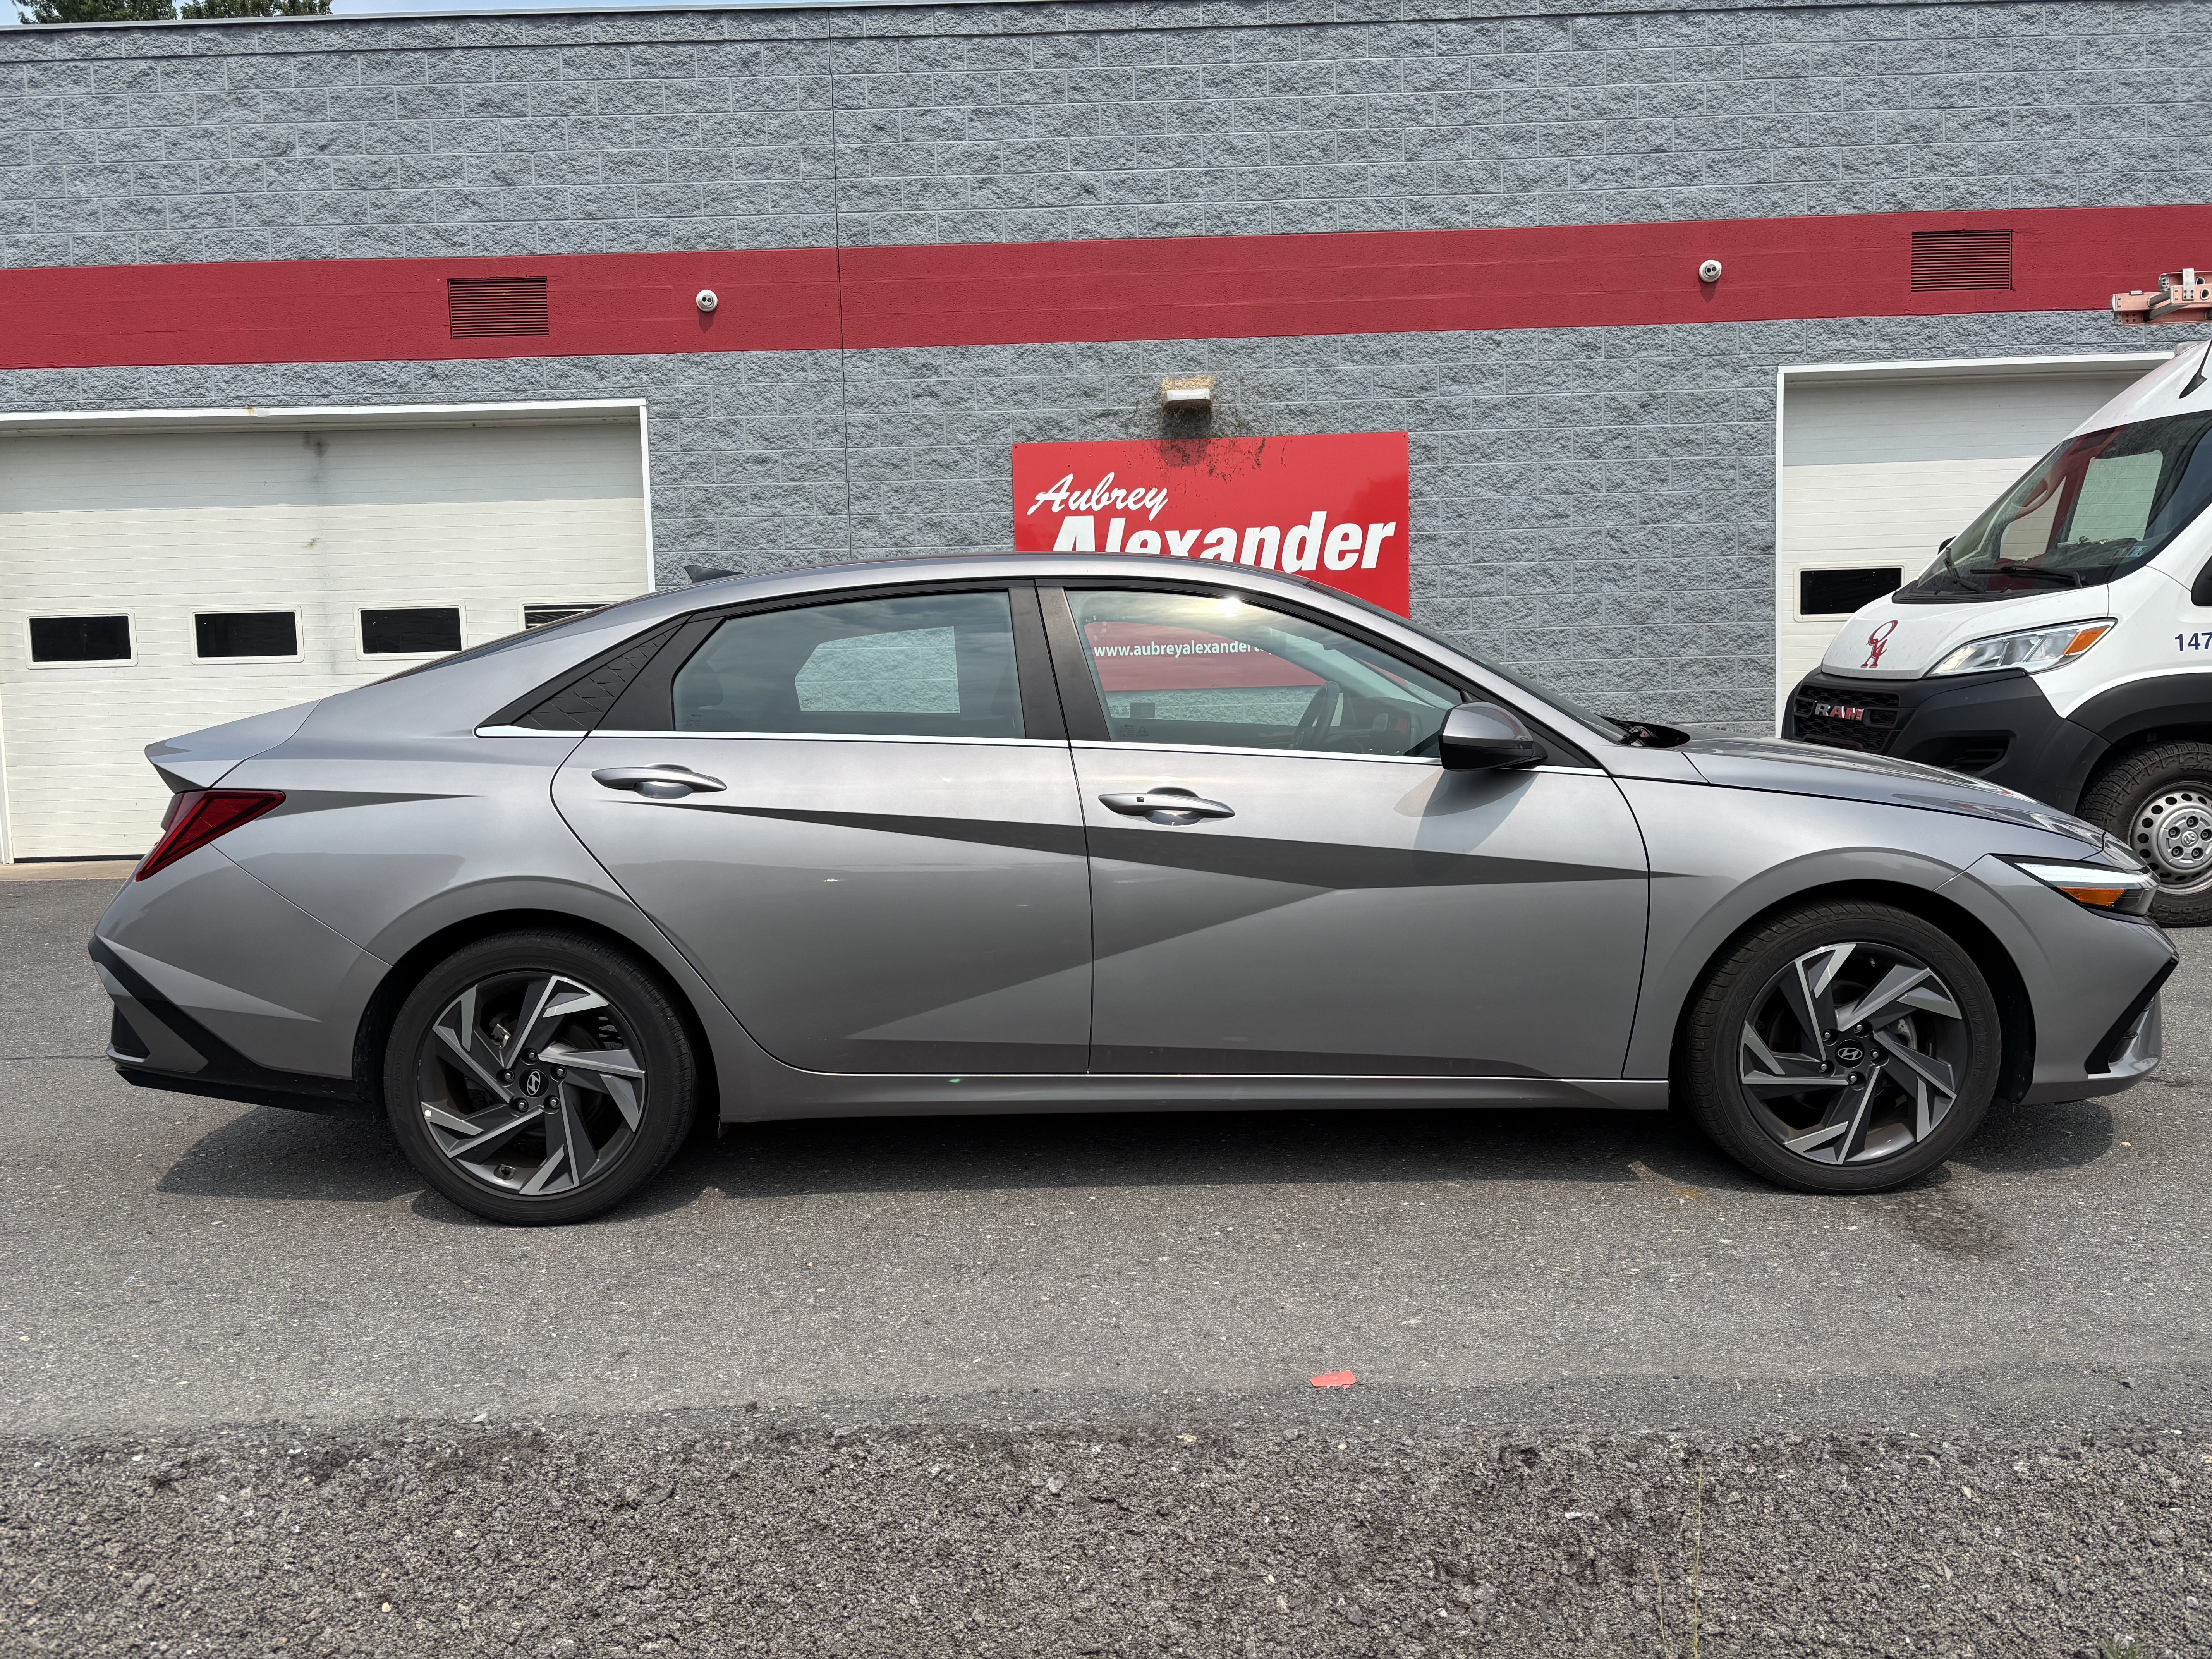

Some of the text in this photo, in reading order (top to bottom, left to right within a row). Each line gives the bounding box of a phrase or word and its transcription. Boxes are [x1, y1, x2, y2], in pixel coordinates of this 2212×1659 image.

[1027, 471, 1168, 521] Aubrey
[1052, 511, 1396, 573] Alexander
[1094, 640, 1272, 658] www.aubreyalexander
[2174, 632, 2212, 651] 147
[1814, 703, 1865, 721] RAM
